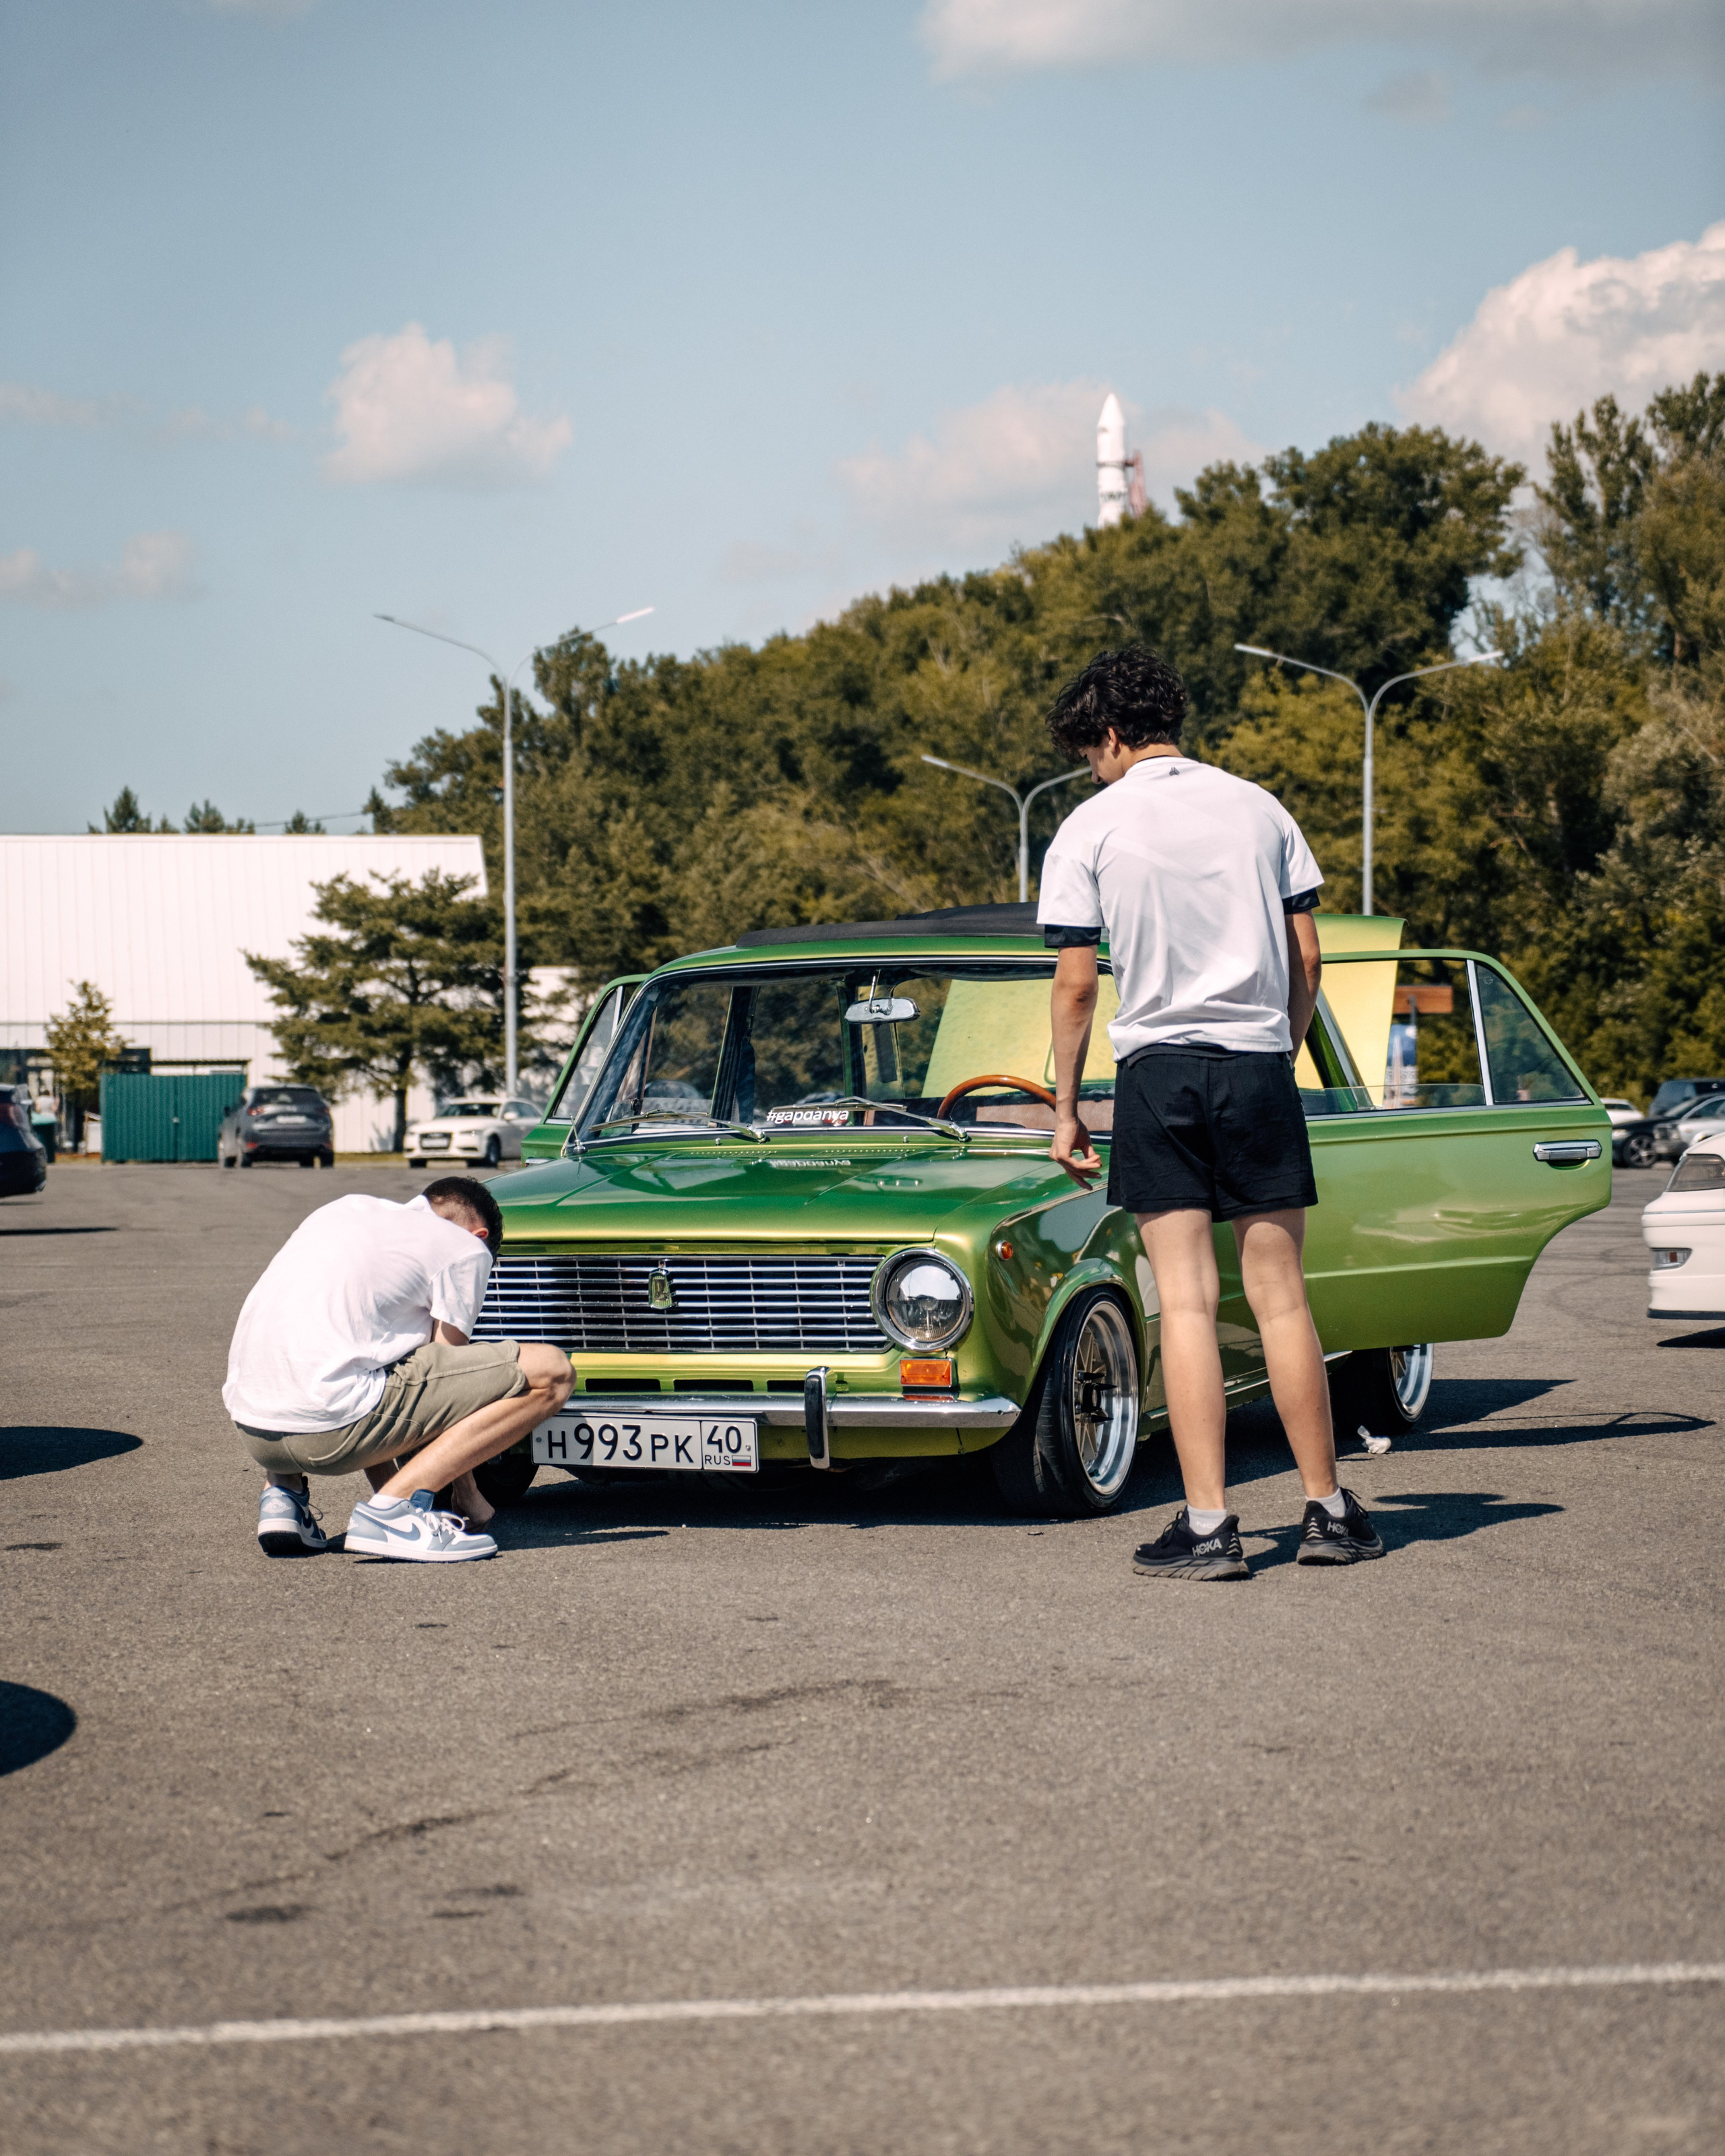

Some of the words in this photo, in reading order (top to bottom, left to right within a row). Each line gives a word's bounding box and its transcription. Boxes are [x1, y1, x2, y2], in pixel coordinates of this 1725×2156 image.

[706, 1424, 742, 1454] 40
[705, 1455, 730, 1465] RUS
[1327, 1521, 1349, 1538] HOKA
[1192, 1537, 1222, 1557] HOKA
